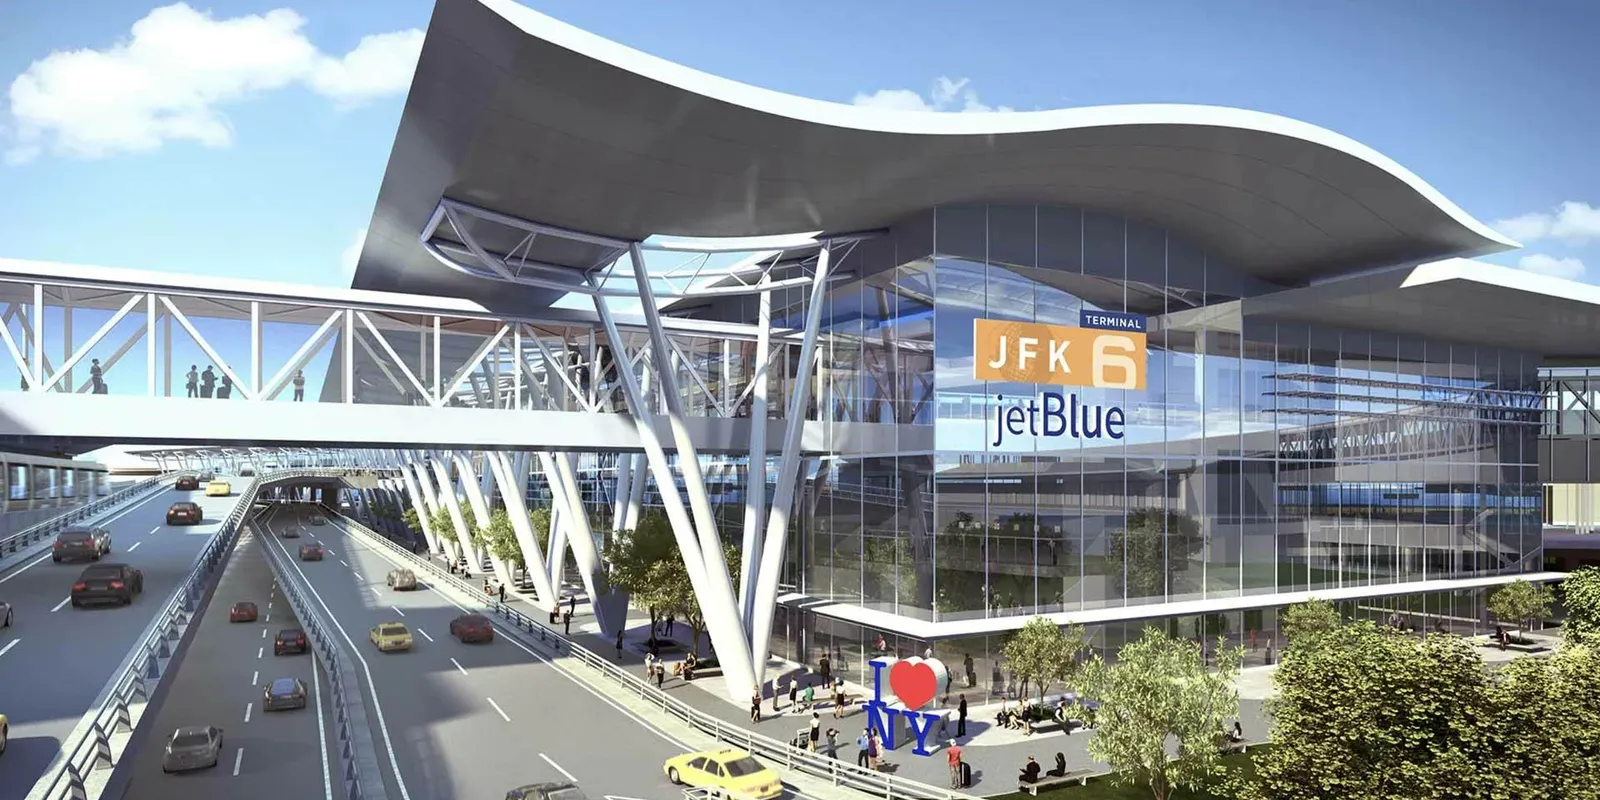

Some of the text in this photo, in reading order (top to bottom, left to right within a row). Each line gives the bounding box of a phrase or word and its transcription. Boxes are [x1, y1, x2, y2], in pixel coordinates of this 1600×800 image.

[1085, 315, 1142, 329] TERMINAL
[988, 334, 1137, 390] JFK 6
[992, 392, 1125, 447] jetBlue
[868, 660, 887, 707] I
[862, 704, 940, 757] NY
